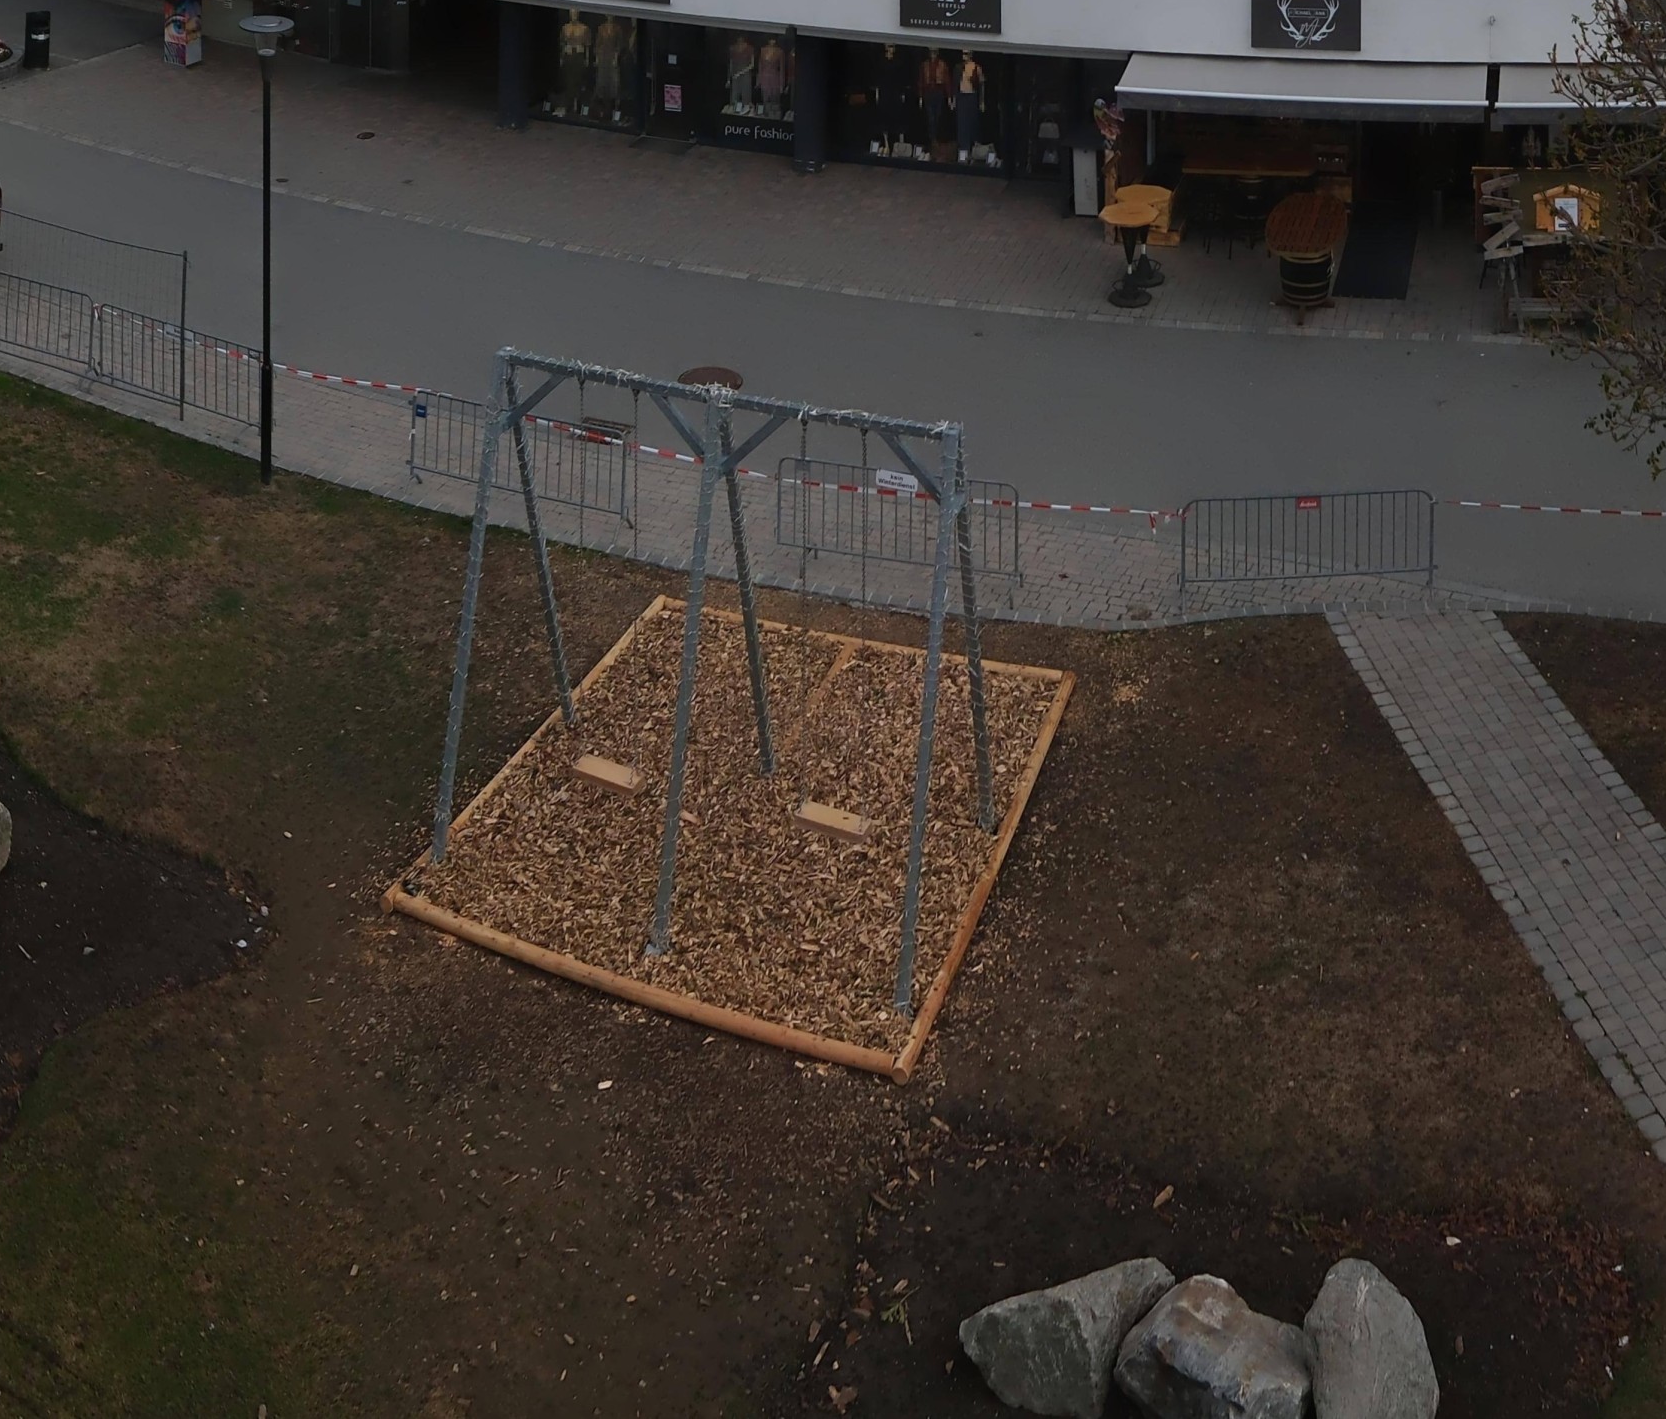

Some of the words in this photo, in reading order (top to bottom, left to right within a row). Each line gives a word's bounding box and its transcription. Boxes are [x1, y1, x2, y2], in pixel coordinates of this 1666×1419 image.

[910, 18, 939, 26] SEEFELD
[941, 20, 976, 29] SHOPPING
[724, 125, 751, 136] pure
